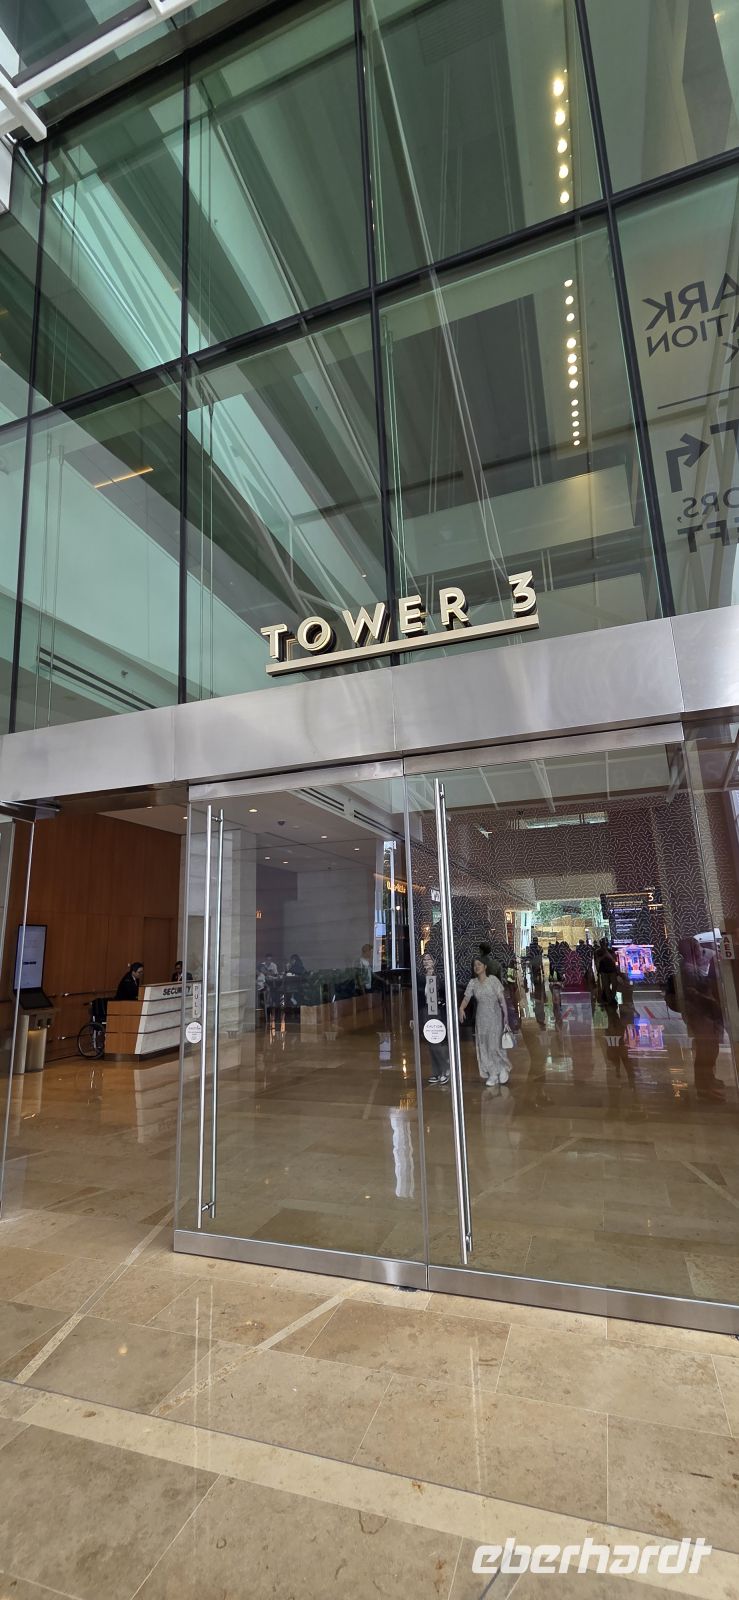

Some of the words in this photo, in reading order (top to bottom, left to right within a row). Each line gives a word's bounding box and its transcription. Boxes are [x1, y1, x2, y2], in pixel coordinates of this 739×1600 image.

[260, 586, 471, 661] TOWER
[508, 570, 537, 617] 3
[723, 936, 732, 958] AED
[428, 978, 436, 1012] PULL
